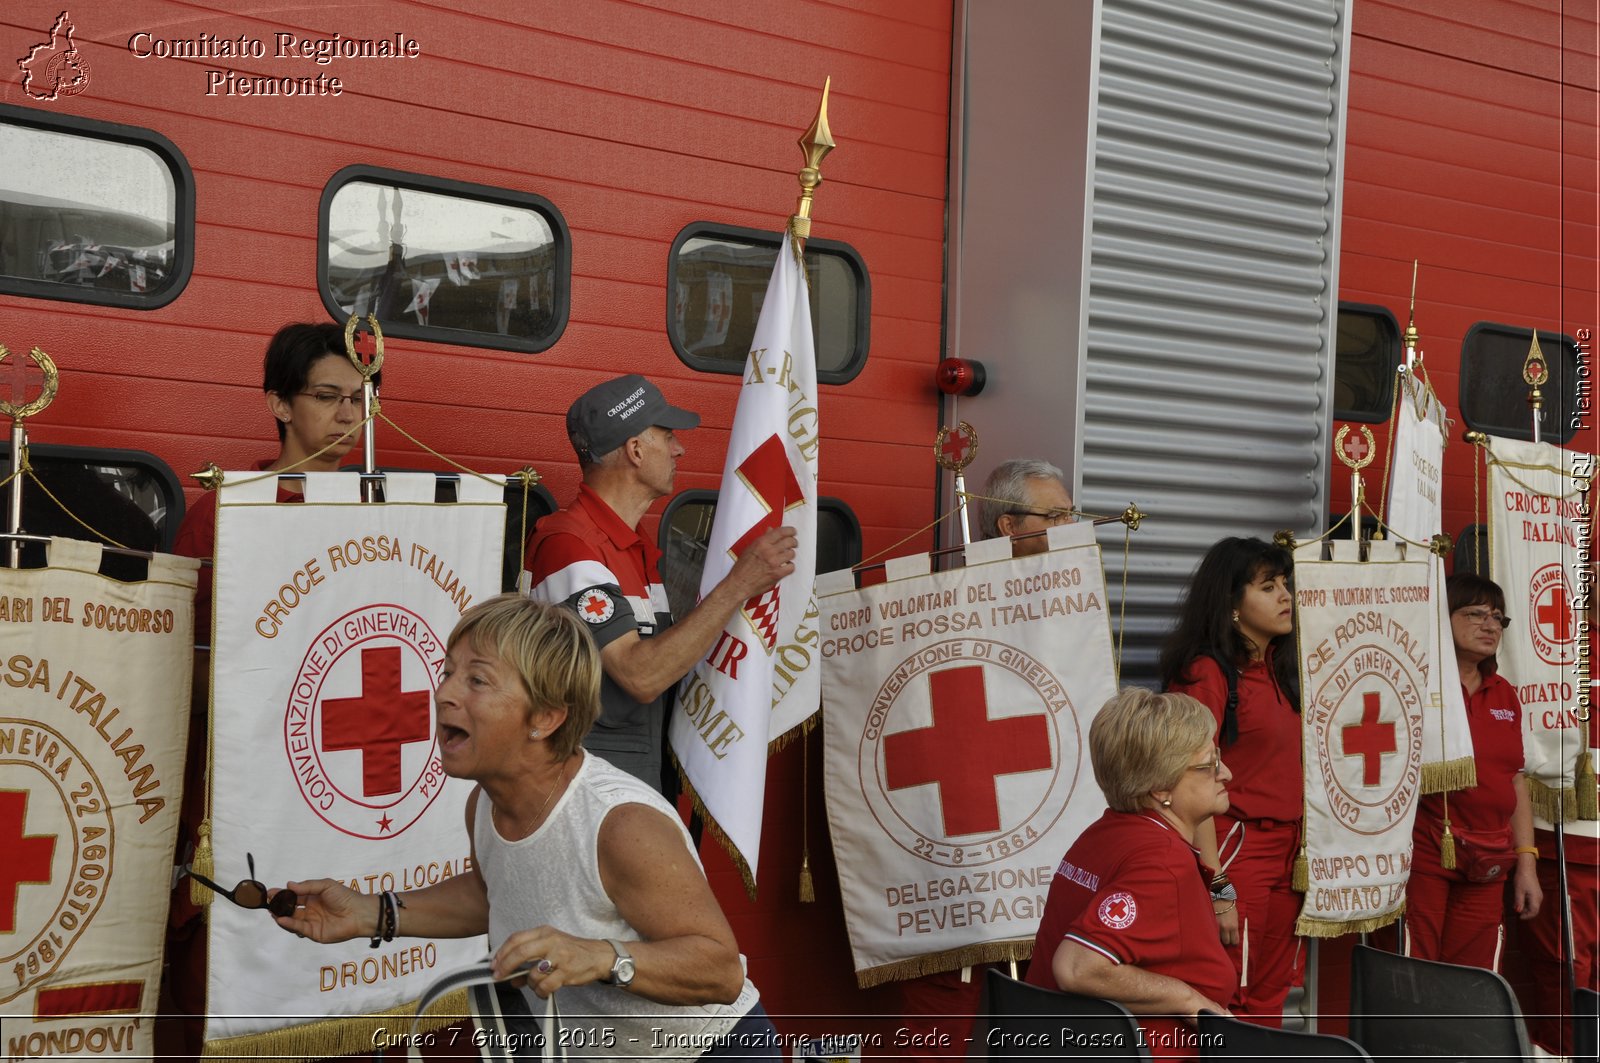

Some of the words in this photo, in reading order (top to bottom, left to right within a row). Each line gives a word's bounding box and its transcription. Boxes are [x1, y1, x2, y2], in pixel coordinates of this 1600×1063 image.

[607, 386, 646, 418] CROIX-ROUGE
[619, 398, 646, 421] MONACO
[1505, 491, 1551, 515] CROCE
[255, 557, 326, 640] CROCE
[327, 535, 403, 573] ROSSA
[830, 605, 872, 632] CORPO
[878, 588, 958, 621] VOLONTARI
[967, 582, 997, 604] DEL
[1004, 567, 1082, 598] SOCCORSO
[1333, 587, 1373, 606] VOLONTARI
[1374, 587, 1389, 604] DEL
[42, 596, 75, 624] DEL
[82, 602, 175, 634] SOCCORSO
[820, 626, 894, 659] CROCE
[901, 611, 983, 643] ROSSA
[991, 591, 1102, 627] ITALIANA
[1334, 610, 1384, 649] ROSSA
[1334, 668, 1351, 692] DI
[1354, 651, 1401, 685] GINEVRA
[864, 642, 963, 742] CONVENZIONE
[972, 642, 992, 659] DI
[998, 648, 1068, 715] GINEVRA
[1400, 684, 1417, 710] 22
[290, 650, 329, 812] CONVENZIONE
[322, 630, 344, 656] DI
[343, 612, 418, 643] GINEVRA
[418, 632, 437, 660] 22
[56, 669, 166, 825] ITALIANA
[1406, 714, 1423, 786] AGOSTO
[69, 781, 101, 819] 22
[1384, 786, 1411, 823] 1864
[58, 825, 107, 932] AGOSTO
[1311, 855, 1370, 880] GRUPPO
[1375, 853, 1395, 876] DI
[886, 865, 1052, 908] DELEGAZIONE
[1315, 886, 1382, 912] COMITATO
[13, 930, 64, 988] 1864
[319, 942, 437, 992] DRONERO
